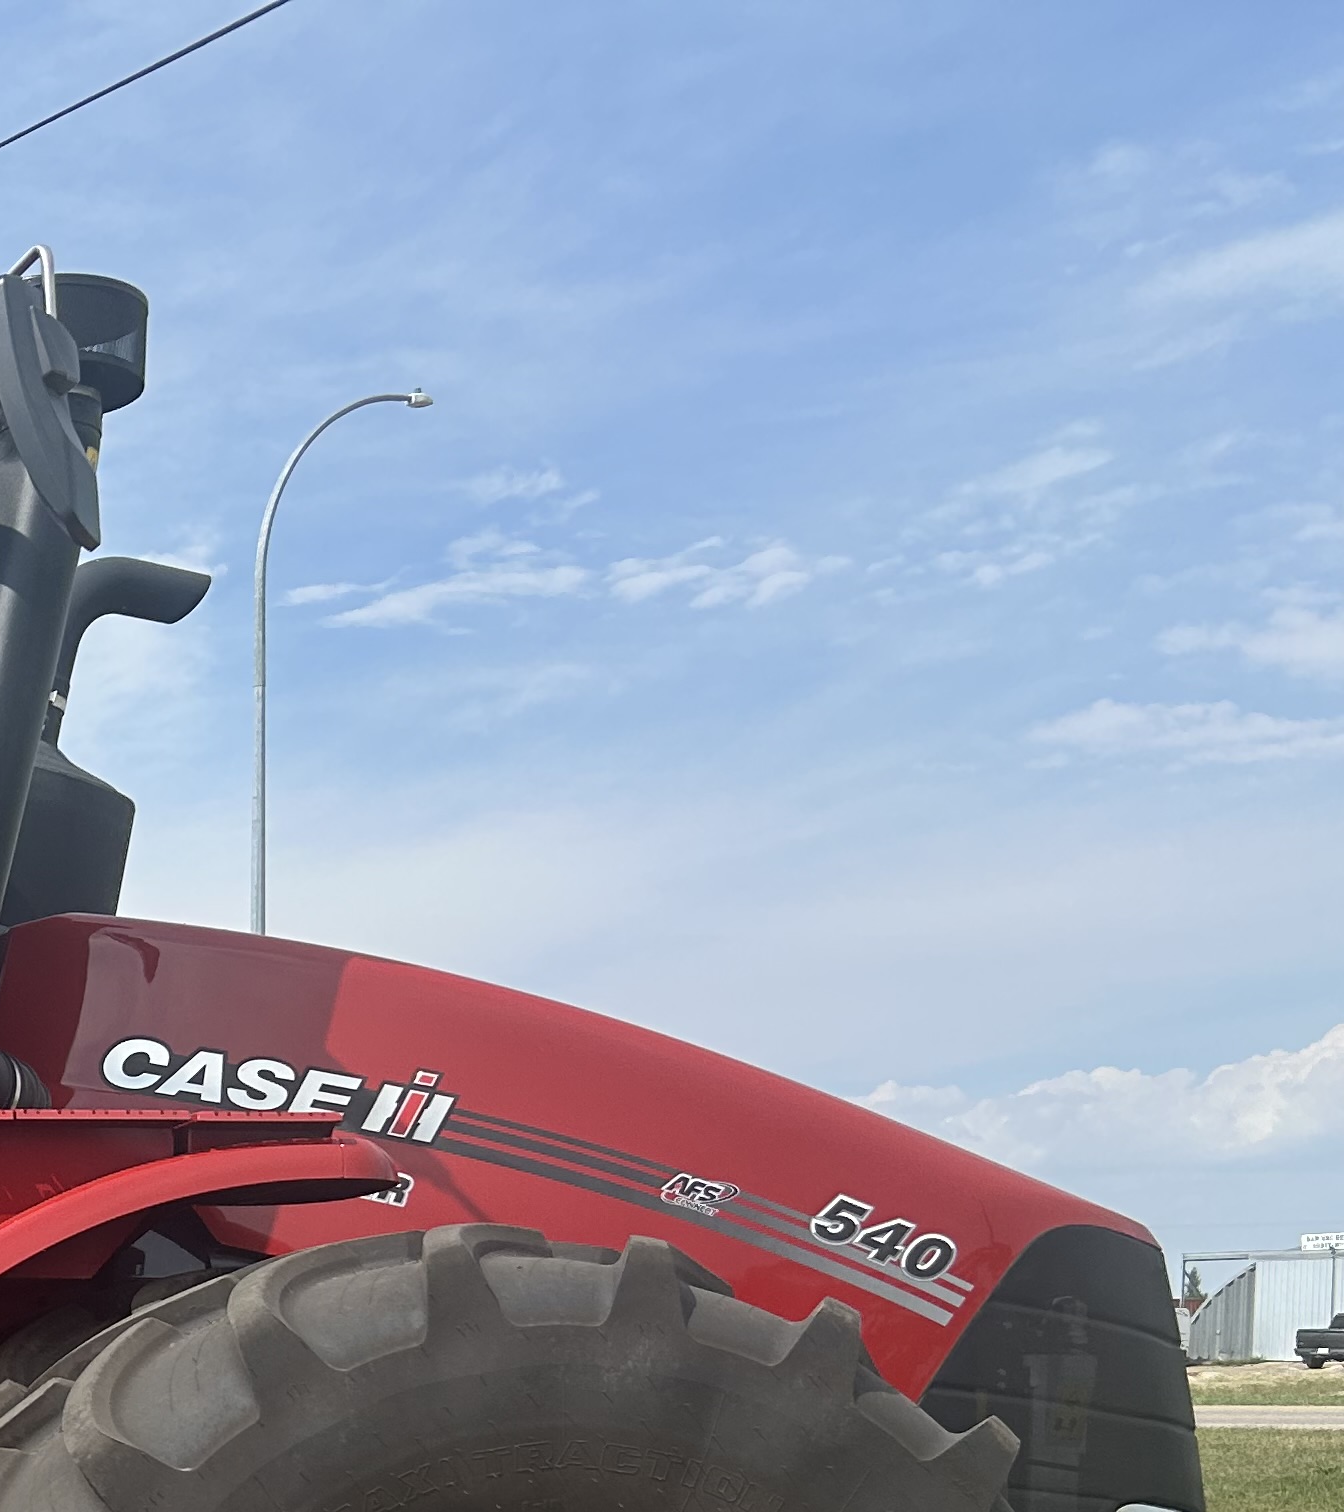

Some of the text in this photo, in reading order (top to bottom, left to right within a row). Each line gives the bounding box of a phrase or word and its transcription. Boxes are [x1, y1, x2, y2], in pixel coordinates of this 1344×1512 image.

[101, 1037, 363, 1113] CASE
[661, 1172, 726, 1203] AFS
[810, 1193, 958, 1282] 540
